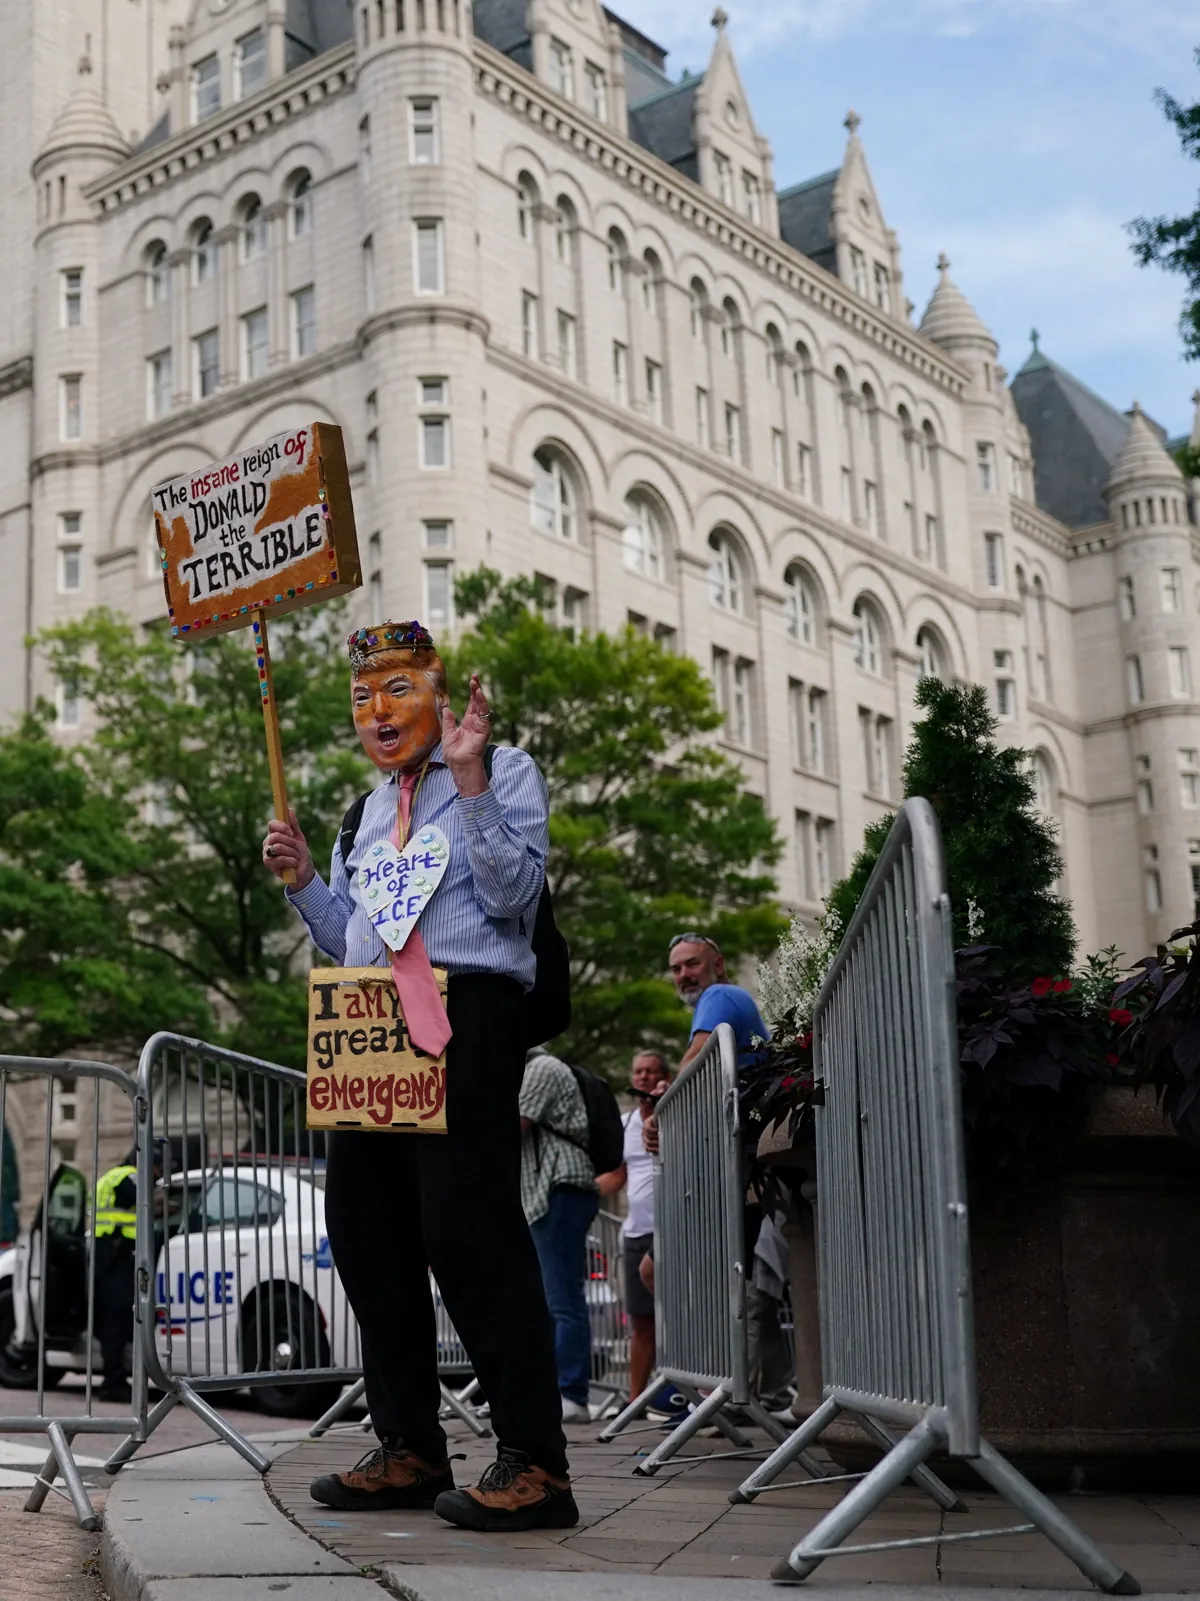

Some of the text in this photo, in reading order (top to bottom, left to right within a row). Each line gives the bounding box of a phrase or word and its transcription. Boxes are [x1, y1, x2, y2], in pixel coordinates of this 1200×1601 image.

[154, 430, 307, 511] The insane reign of
[188, 481, 266, 544] DONALD
[219, 523, 246, 547] the
[183, 513, 322, 599] TERRIBLE
[363, 851, 441, 889] Heart
[387, 873, 409, 898] of
[312, 982, 340, 1021] I
[313, 1018, 428, 1070] great
[156, 1271, 234, 1304] LICE
